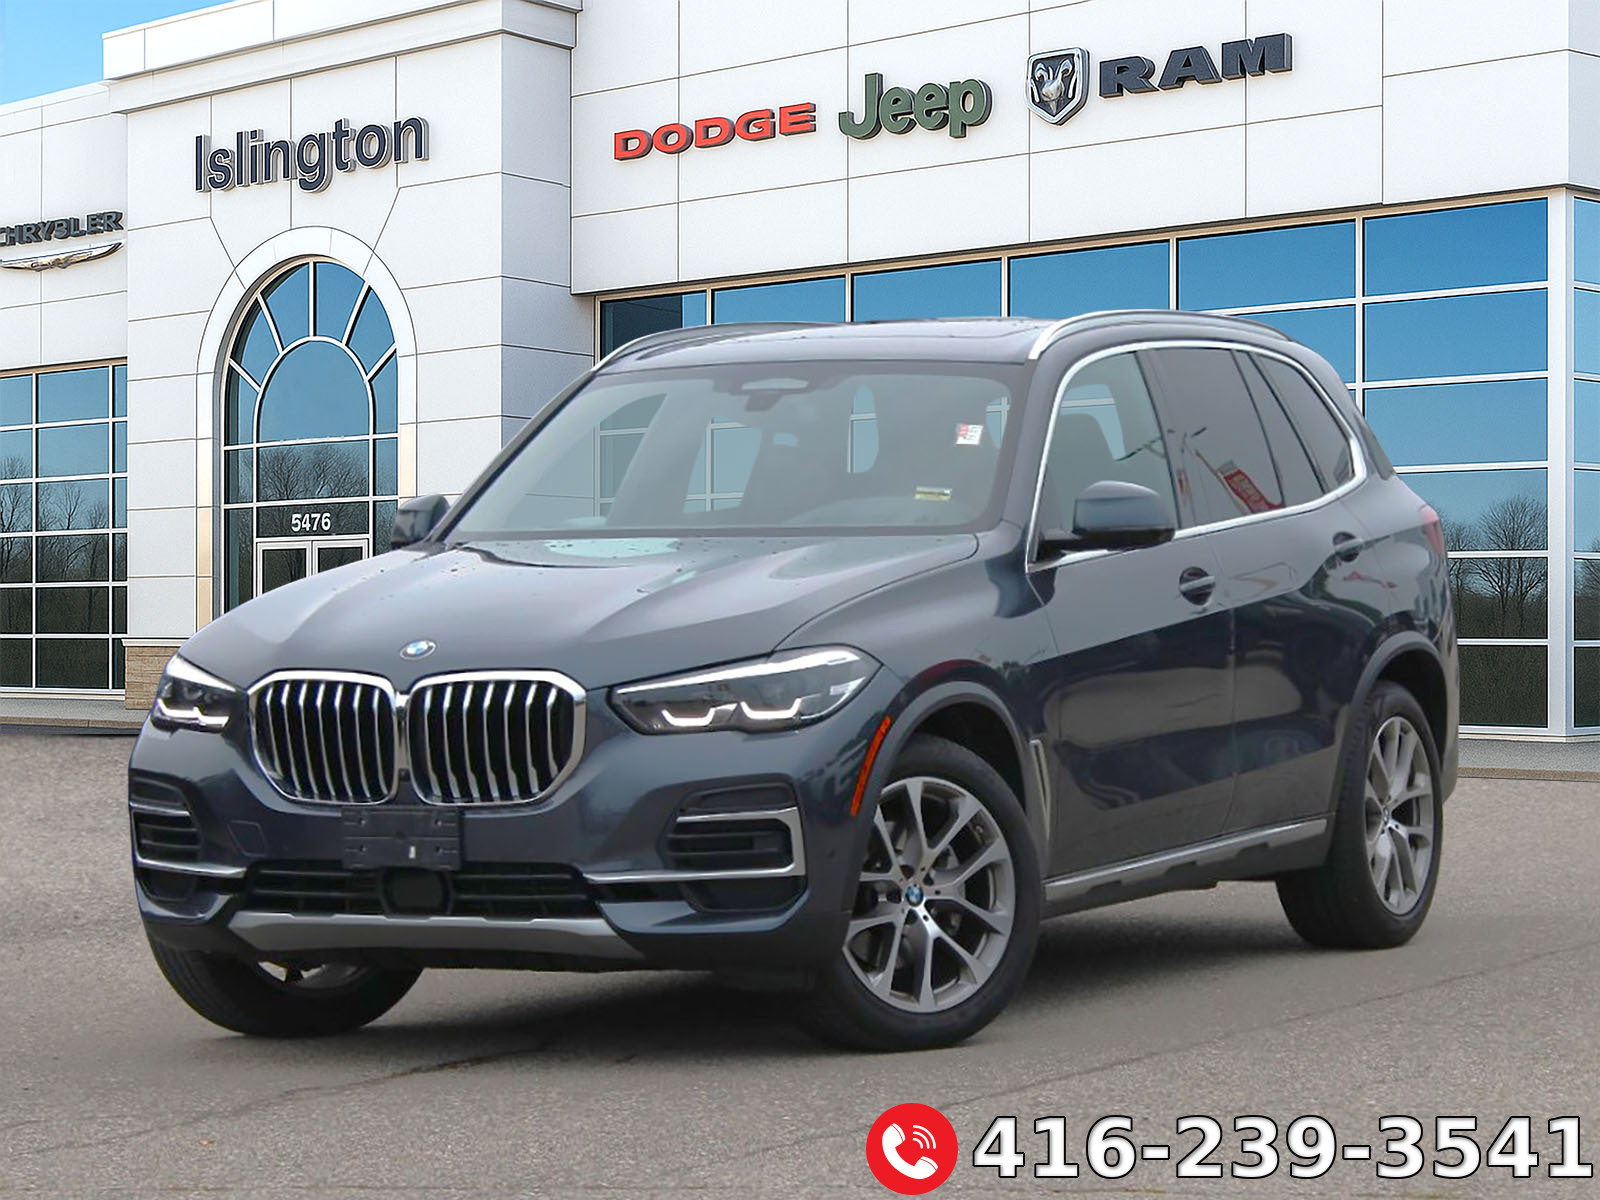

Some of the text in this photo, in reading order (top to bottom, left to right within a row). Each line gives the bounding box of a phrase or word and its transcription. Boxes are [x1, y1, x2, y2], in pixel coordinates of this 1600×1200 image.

[1100, 33, 1293, 98] RAM
[614, 102, 818, 160] DODGE
[839, 73, 993, 139] Jeep
[194, 116, 430, 192] Islington
[291, 512, 331, 532] 5476
